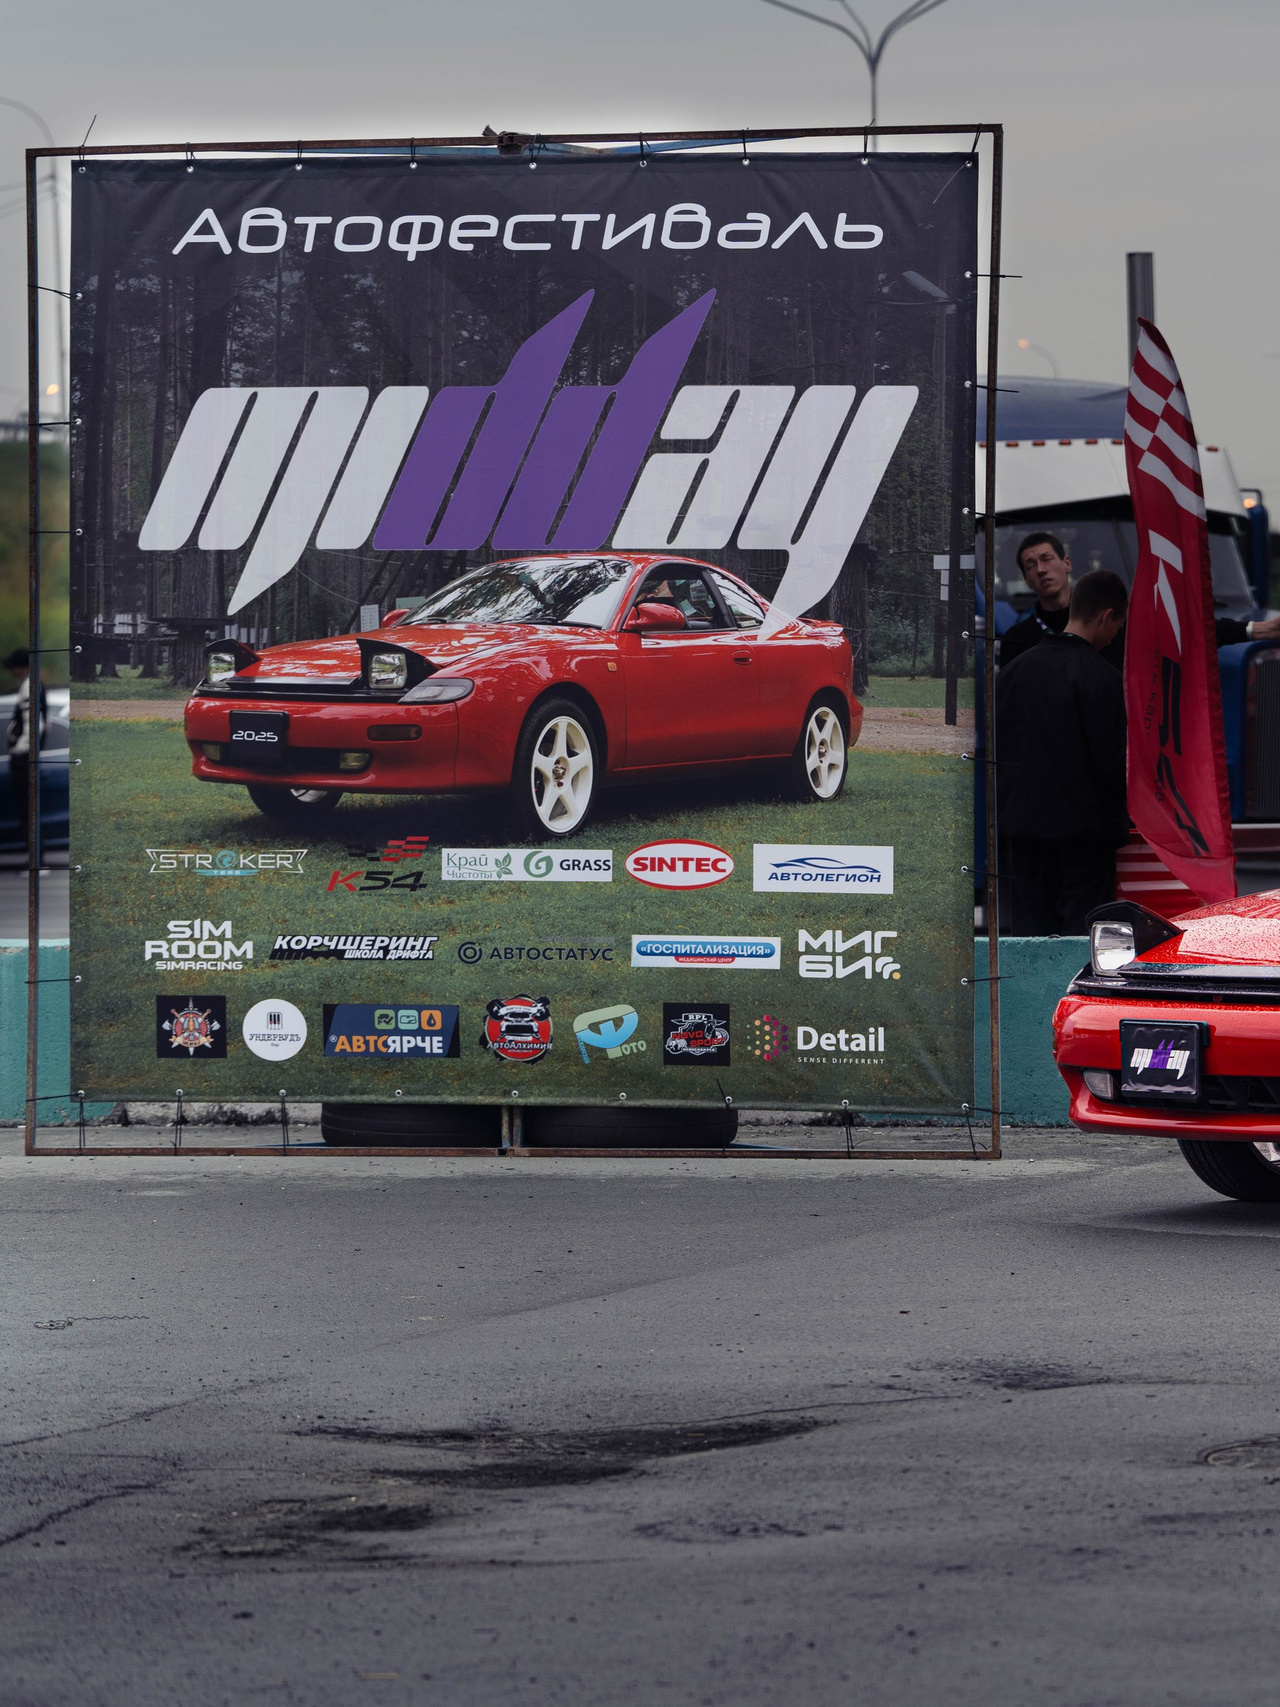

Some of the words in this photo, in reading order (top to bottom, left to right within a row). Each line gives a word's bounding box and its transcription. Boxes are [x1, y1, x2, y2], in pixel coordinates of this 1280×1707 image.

[172, 203, 884, 262] Автофестиваль
[232, 730, 278, 742] 2025
[446, 853, 488, 870] Край
[559, 859, 612, 871] GRASS
[633, 857, 727, 873] SINTEC
[326, 870, 428, 892] K54
[446, 870, 493, 879] Чистоты
[768, 872, 882, 883] АВТОЛЕГИОН
[166, 918, 232, 941] SIM
[273, 935, 438, 950] КОРЧШЕРИНГ
[798, 929, 898, 953] МИГ
[145, 940, 254, 961] ROOM
[343, 949, 384, 959] ШКОЛА
[386, 950, 433, 960] ДРИФТА
[489, 947, 614, 962] АВТОСТАТУС
[155, 961, 243, 971] SIMRACING
[797, 1026, 885, 1052] Detail
[832, 1057, 885, 1065] DIFFERENT
